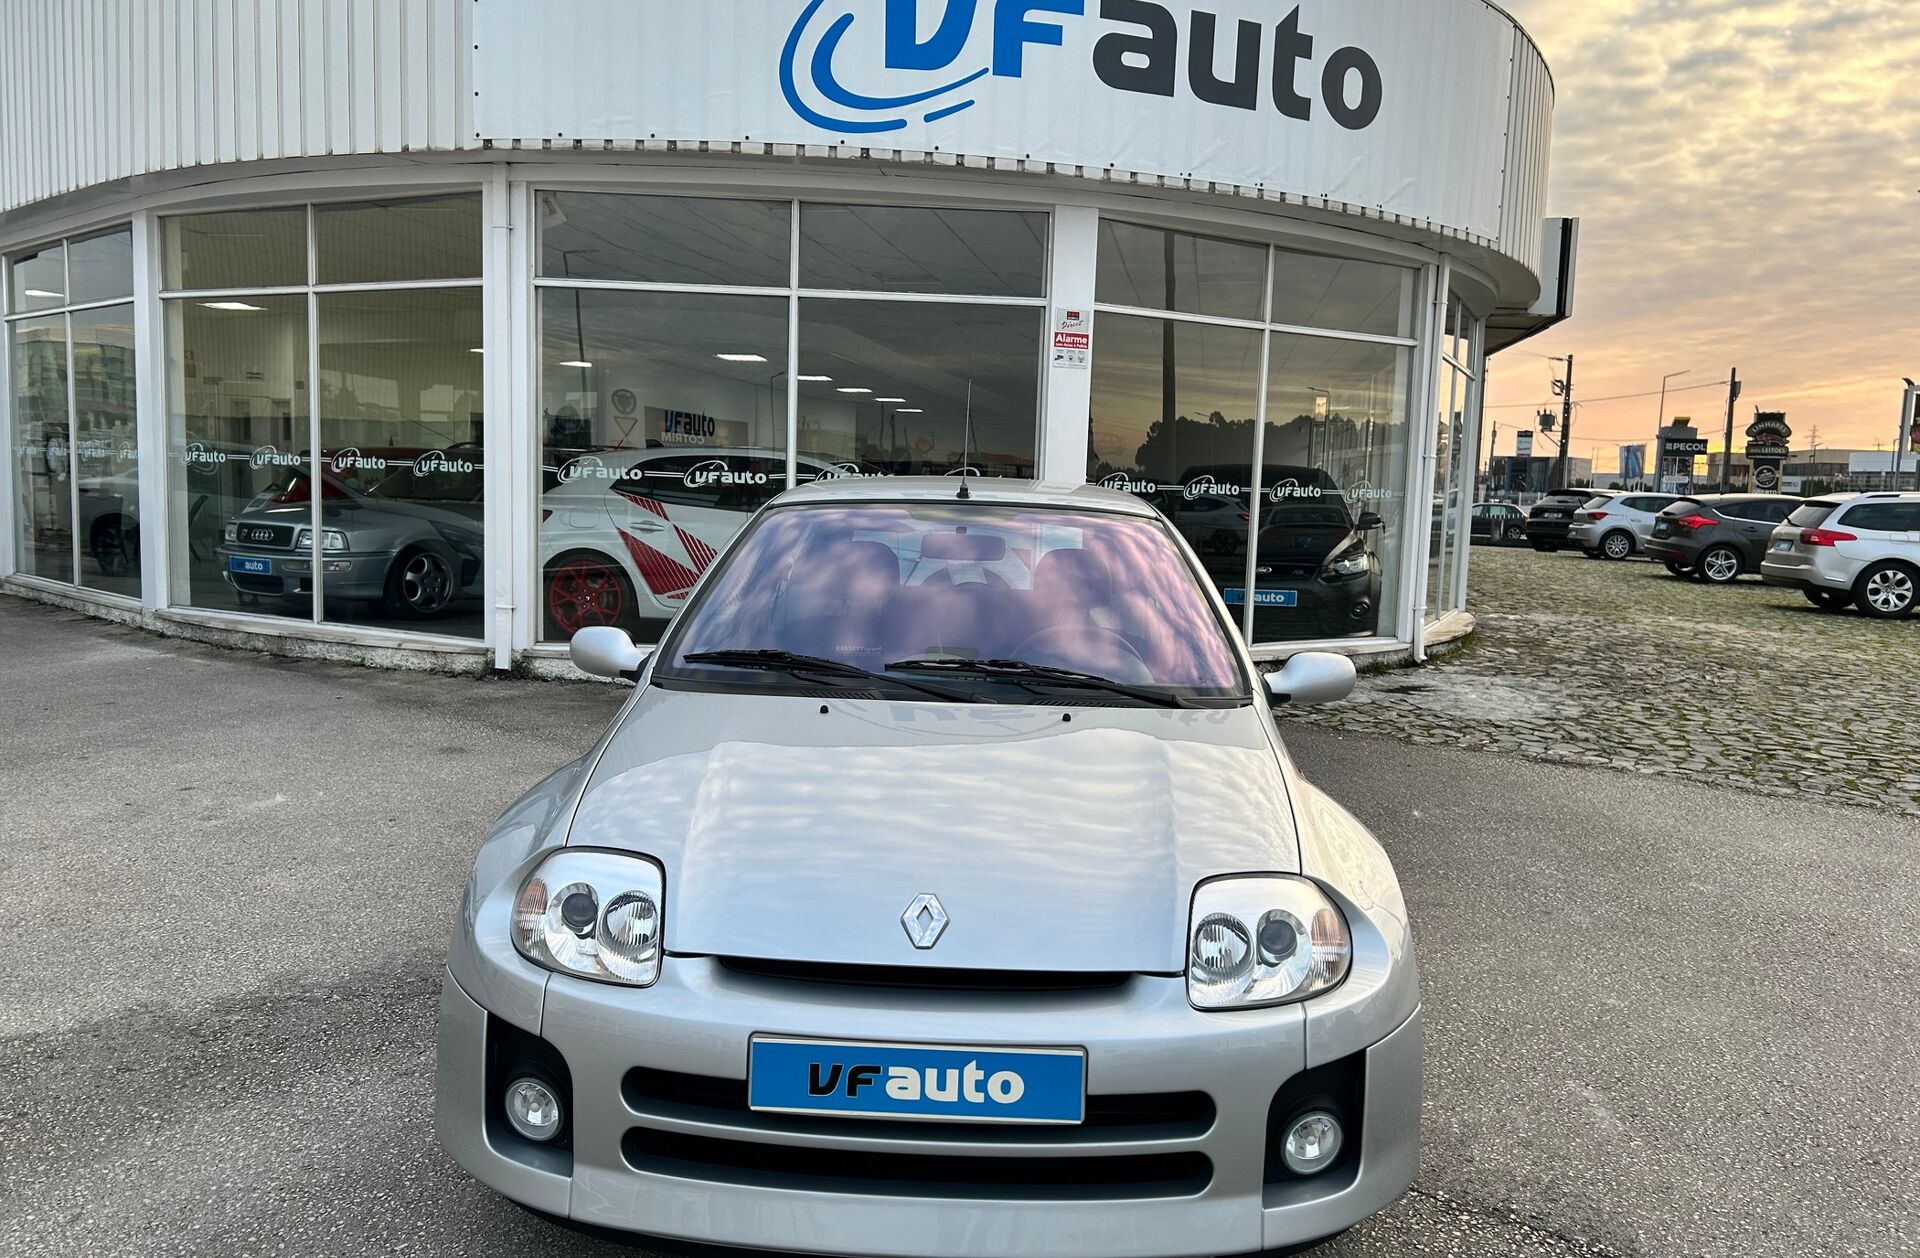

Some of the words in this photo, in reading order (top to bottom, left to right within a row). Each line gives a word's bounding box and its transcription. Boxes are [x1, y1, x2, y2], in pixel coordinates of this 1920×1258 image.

[1056, 333, 1088, 344] Alarme
[1673, 442, 1705, 451] PECOL
[807, 1059, 1025, 1104] VFauto
